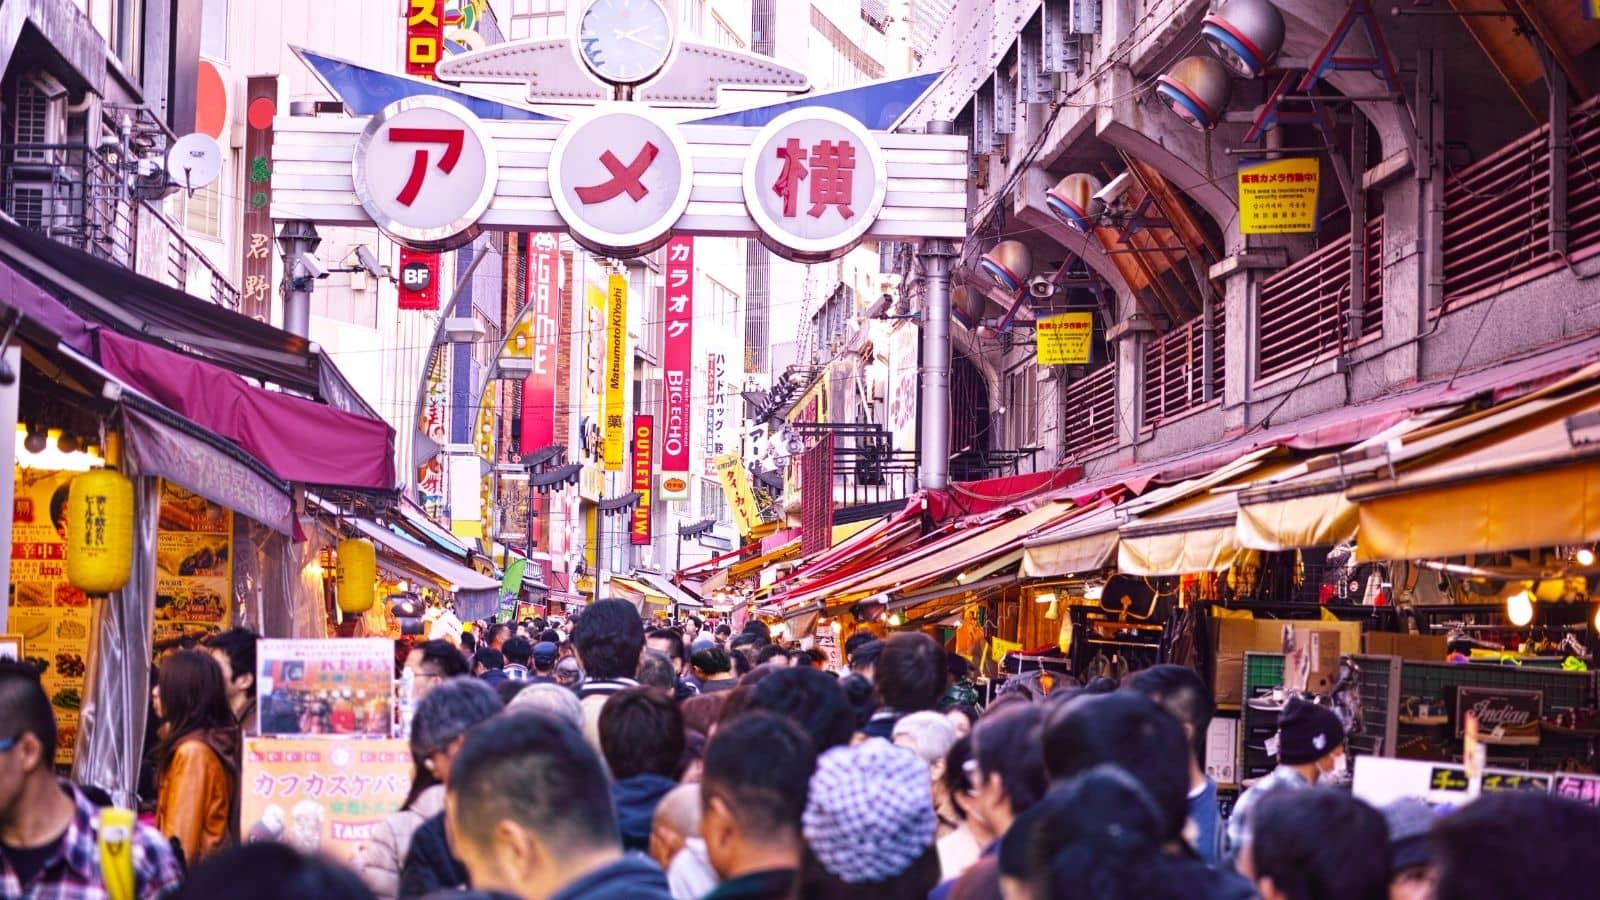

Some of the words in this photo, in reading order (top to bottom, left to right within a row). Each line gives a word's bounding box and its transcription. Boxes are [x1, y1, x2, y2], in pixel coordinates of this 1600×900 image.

[389, 128, 855, 220] アメ横
[244, 233, 271, 323] 君野
[404, 268, 429, 284] BF
[667, 244, 690, 338] カラオケ
[535, 253, 555, 374] GAME
[667, 370, 684, 403] BIG
[607, 415, 623, 429] 薬
[665, 407, 683, 456] ECHO
[637, 426, 650, 486] OUTLET
[1470, 699, 1530, 725] Indian
[334, 822, 378, 840] TAKE
